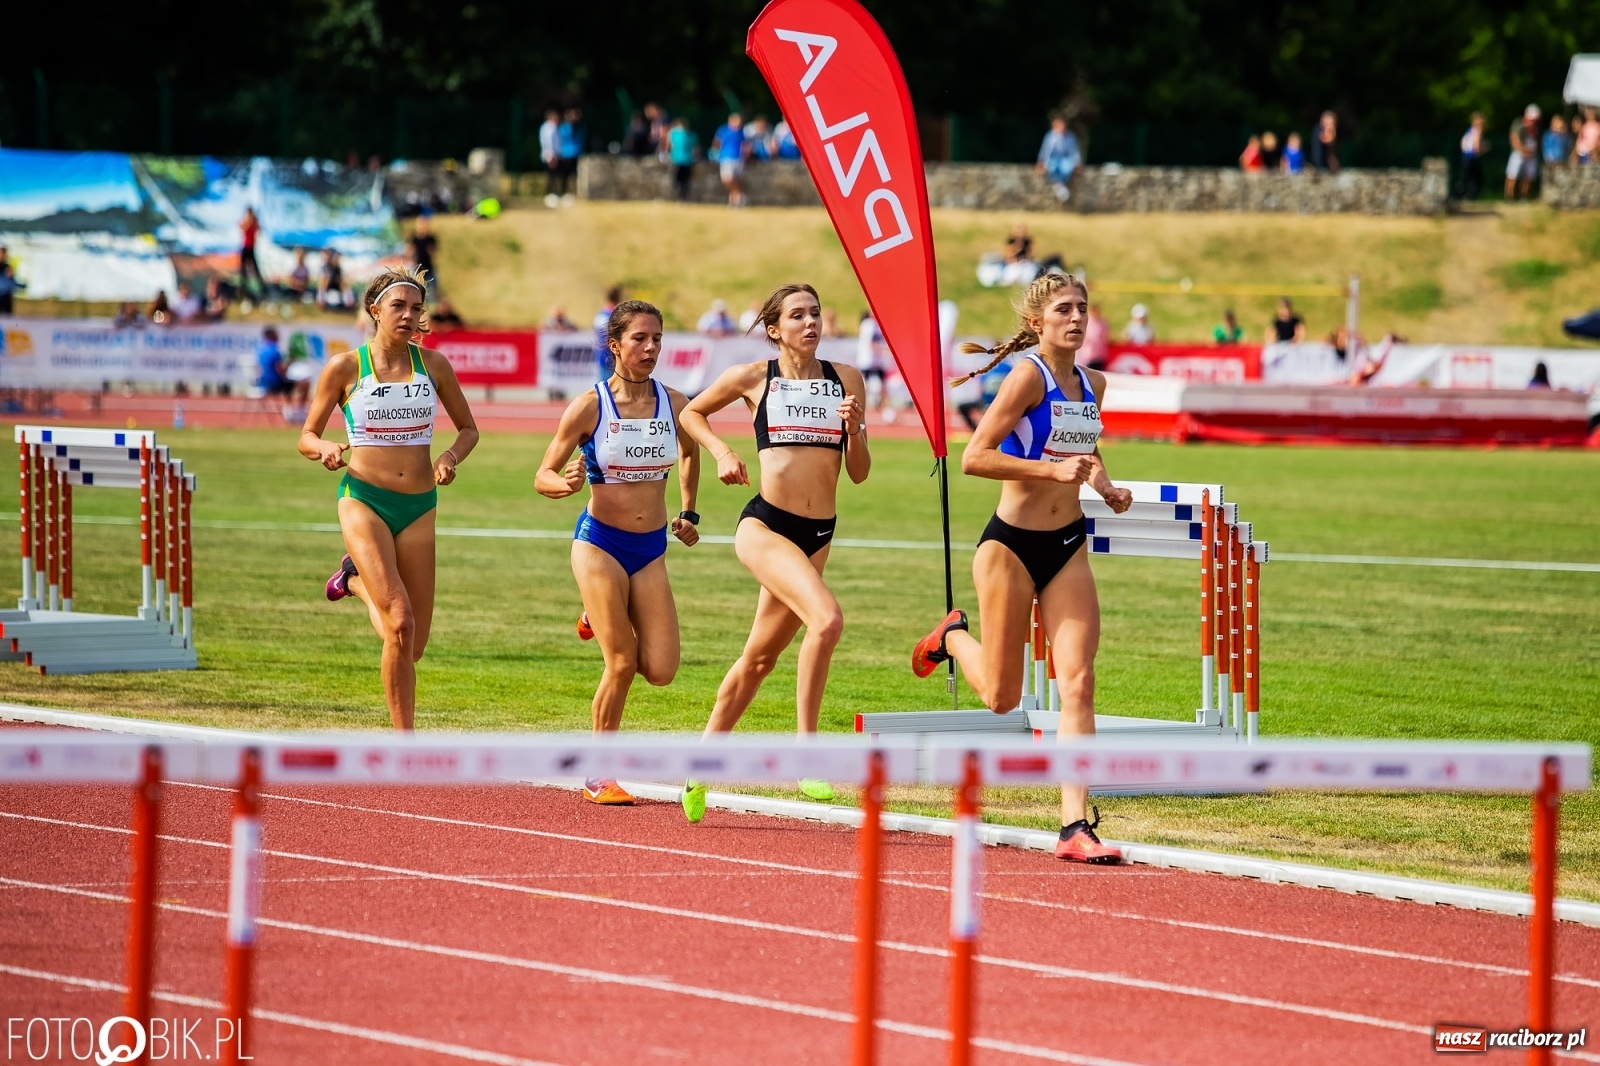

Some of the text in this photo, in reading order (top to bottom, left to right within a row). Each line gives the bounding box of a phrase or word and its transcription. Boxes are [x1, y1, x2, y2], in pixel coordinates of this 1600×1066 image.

[403, 384, 431, 398] 175
[810, 382, 841, 397] 518
[367, 407, 432, 420] DZIAŁOSZEWSKA
[785, 404, 827, 419] TYPER
[649, 421, 671, 436] 594
[777, 431, 833, 443] RACIBÓRZ 2019
[1051, 430, 1099, 444] ŁACHOWSK
[625, 444, 665, 458] KOPEĆ
